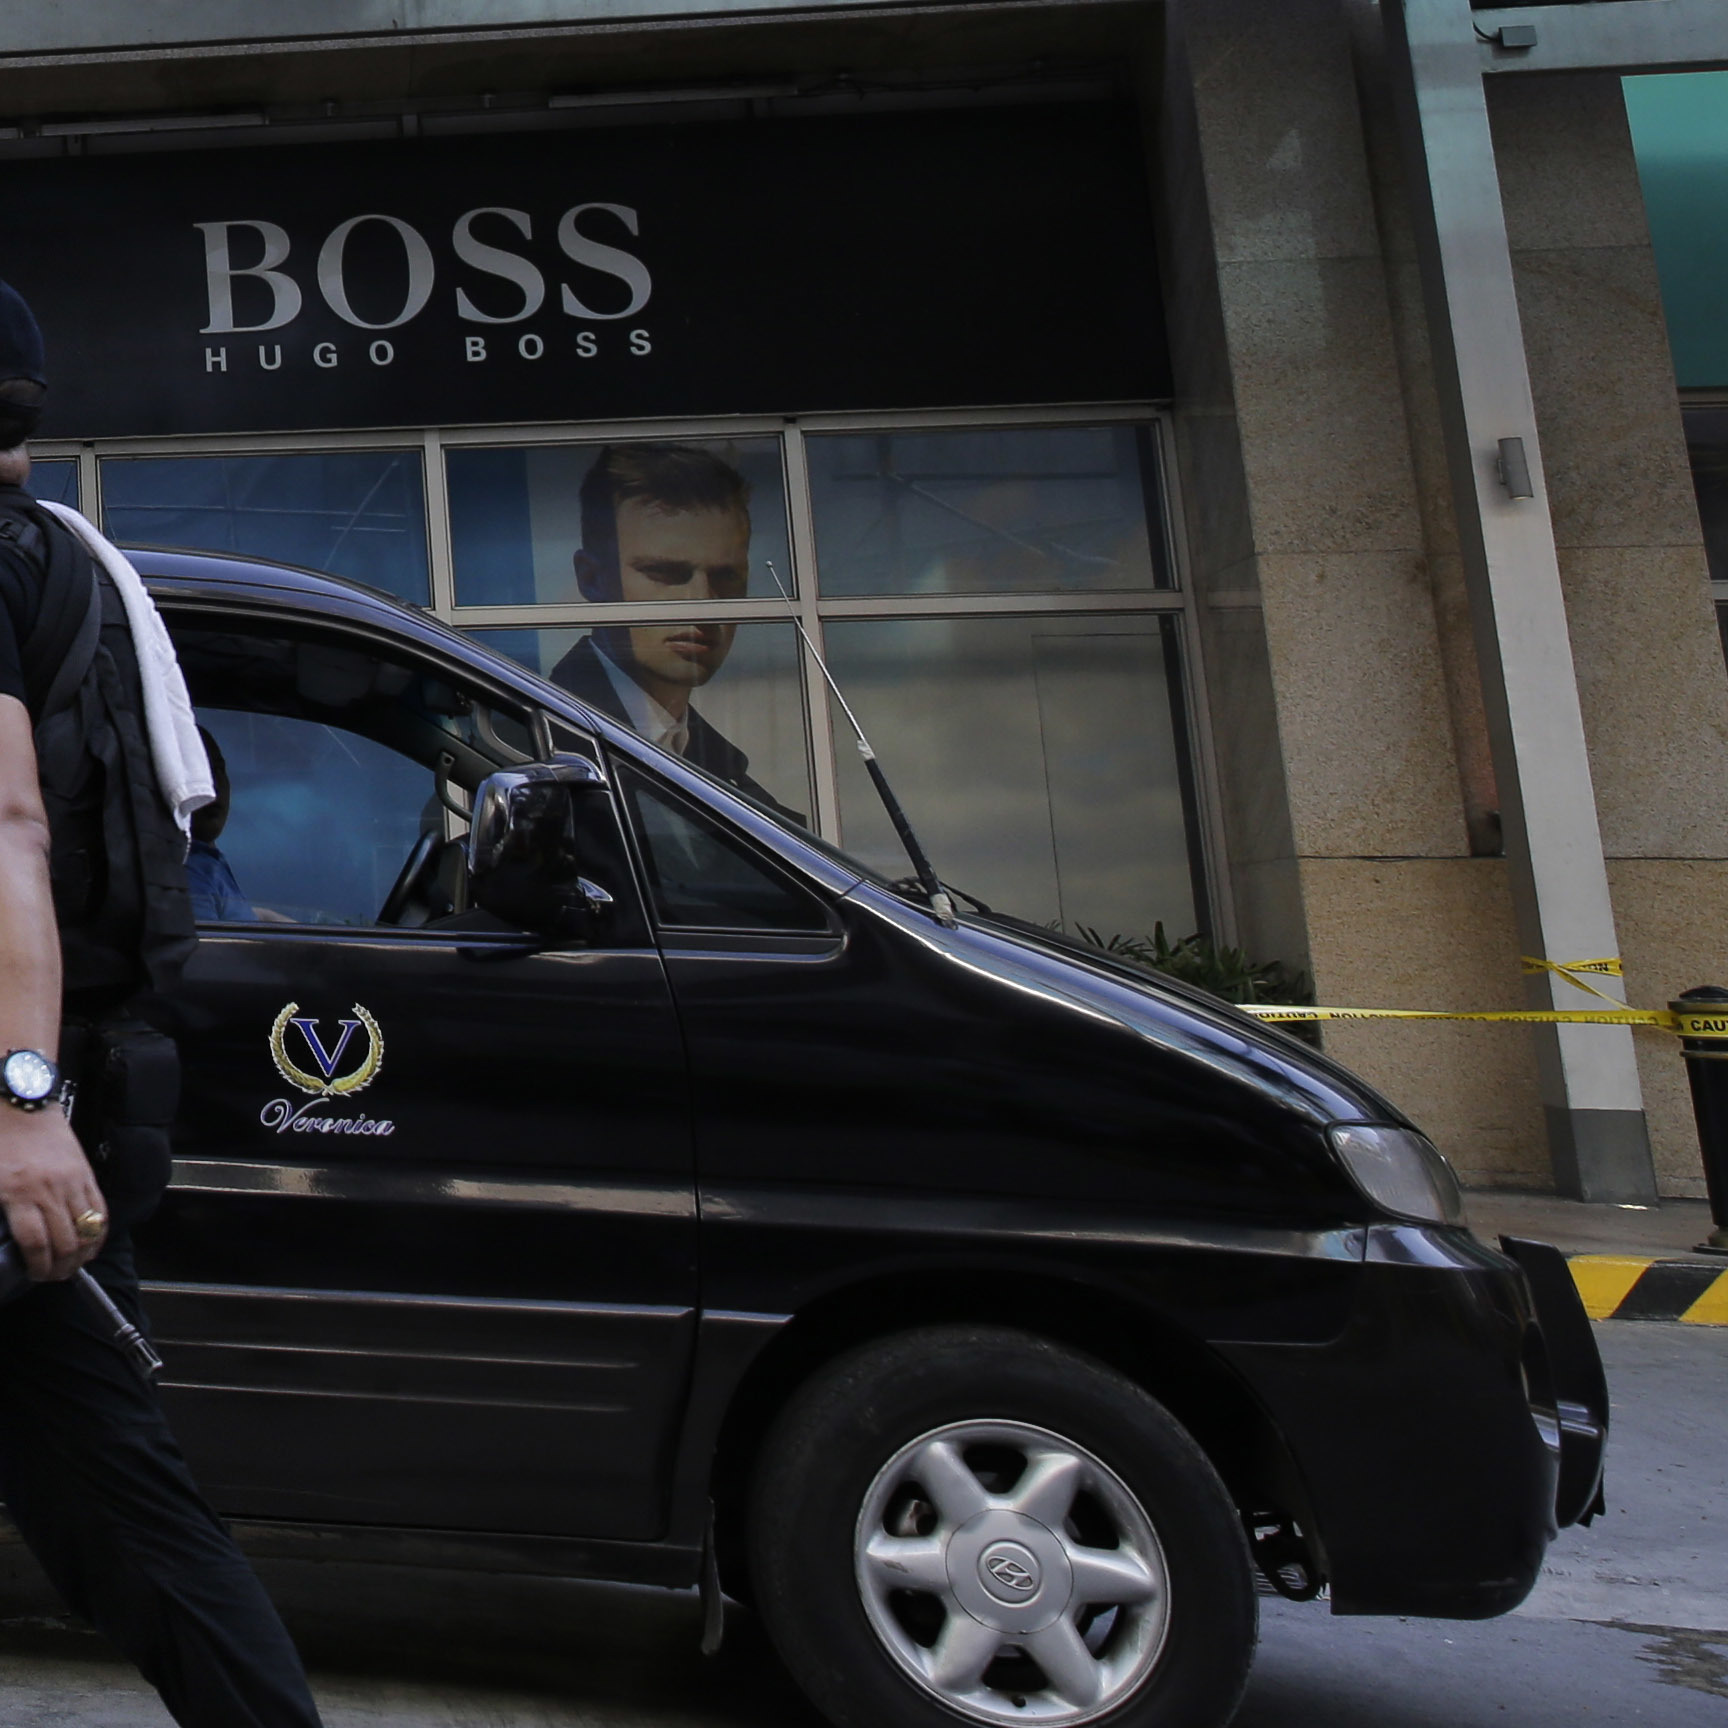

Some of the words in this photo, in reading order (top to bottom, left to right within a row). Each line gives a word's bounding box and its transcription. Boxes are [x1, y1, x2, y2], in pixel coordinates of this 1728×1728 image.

[193, 202, 652, 335] BOSS
[204, 339, 397, 373] HUGO
[465, 328, 653, 363] BOSS
[290, 1018, 361, 1077] V
[1690, 1019, 1728, 1032] CAU
[260, 1097, 395, 1135] Veronica
